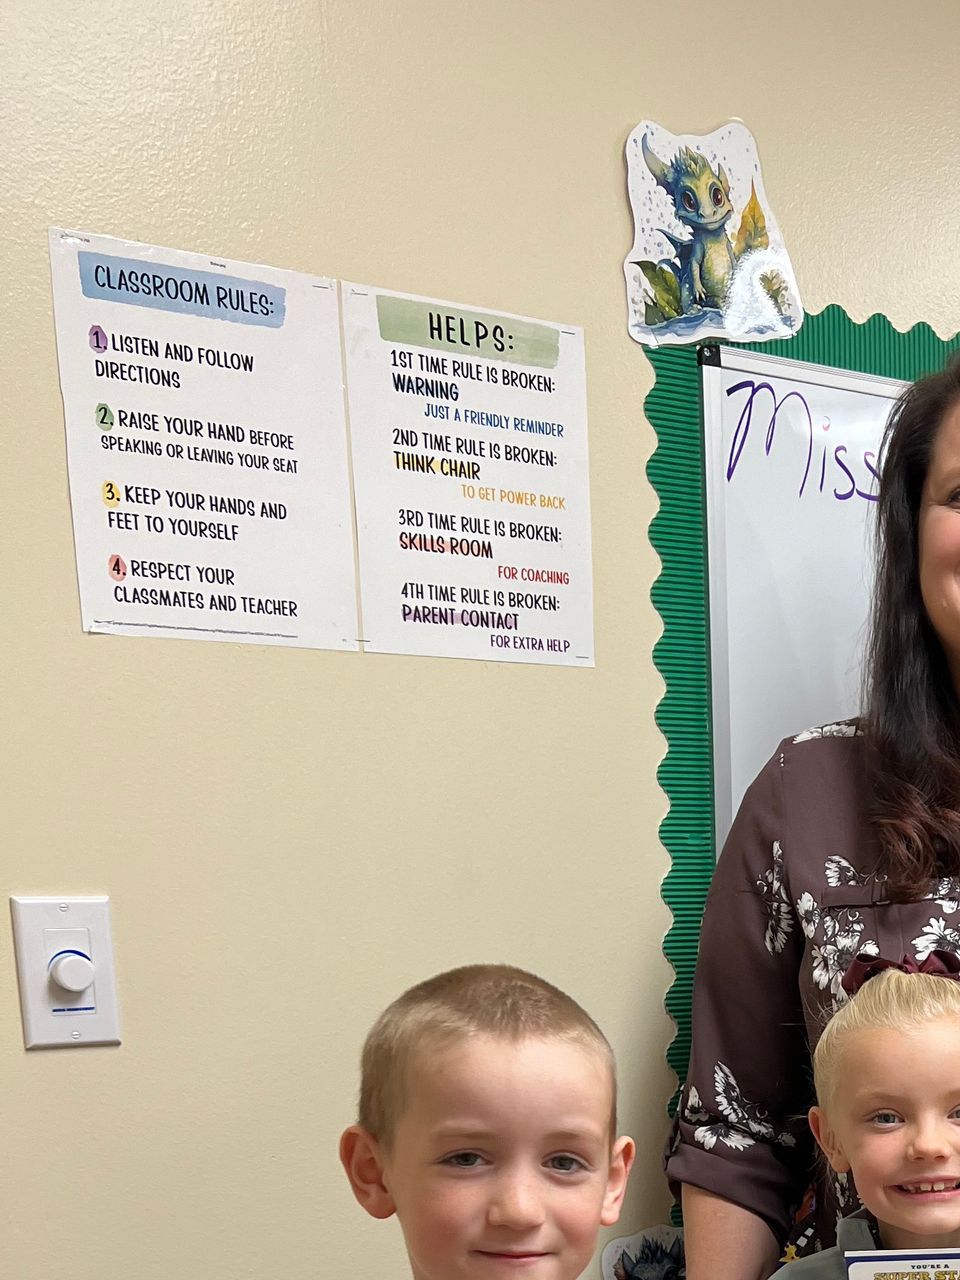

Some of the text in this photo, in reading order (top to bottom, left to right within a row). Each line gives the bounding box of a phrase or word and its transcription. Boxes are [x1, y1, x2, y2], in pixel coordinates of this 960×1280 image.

[94, 265, 274, 316] CLASSROOM RULES:
[428, 312, 514, 352] HELPS:
[92, 328, 253, 372] 1. LISTEN AND FOLLOW
[95, 360, 180, 388] DIRECTIONS
[391, 350, 555, 393] 1ST TIME RULE IS BROKEN:
[392, 369, 461, 402] WARNING
[98, 406, 294, 450] 2. RAISE YOUR HAND BEFORE
[424, 403, 564, 438] JUST A FRIENDLY REMINDER
[101, 435, 298, 474] SPEAKING OR LEAVING YOUR SEAT
[392, 428, 557, 467] 2ND TIME RULE IS BROKEN:
[726, 380, 882, 502] Miss
[393, 450, 480, 480] THINK CHAIR
[106, 483, 286, 520] 3. KEEP YOUR HANDS AND
[462, 484, 564, 508] TO GET POWER BACK
[108, 511, 238, 541] FEET TO YOURSELF
[399, 509, 562, 542] 3RD TIME RULE IS BROKEN:
[399, 531, 493, 559] SKILLS ROOM
[112, 558, 234, 586] 4. RESPECT YOUR
[498, 566, 569, 584] FOR COACHING
[114, 586, 297, 617] CLASSMATES AND TEACHER
[401, 582, 560, 611] 4TH TIME RULE IS BROKEN:
[402, 604, 519, 631] PARENT CONTACT
[490, 634, 570, 652] FOR EXTRA HELP
